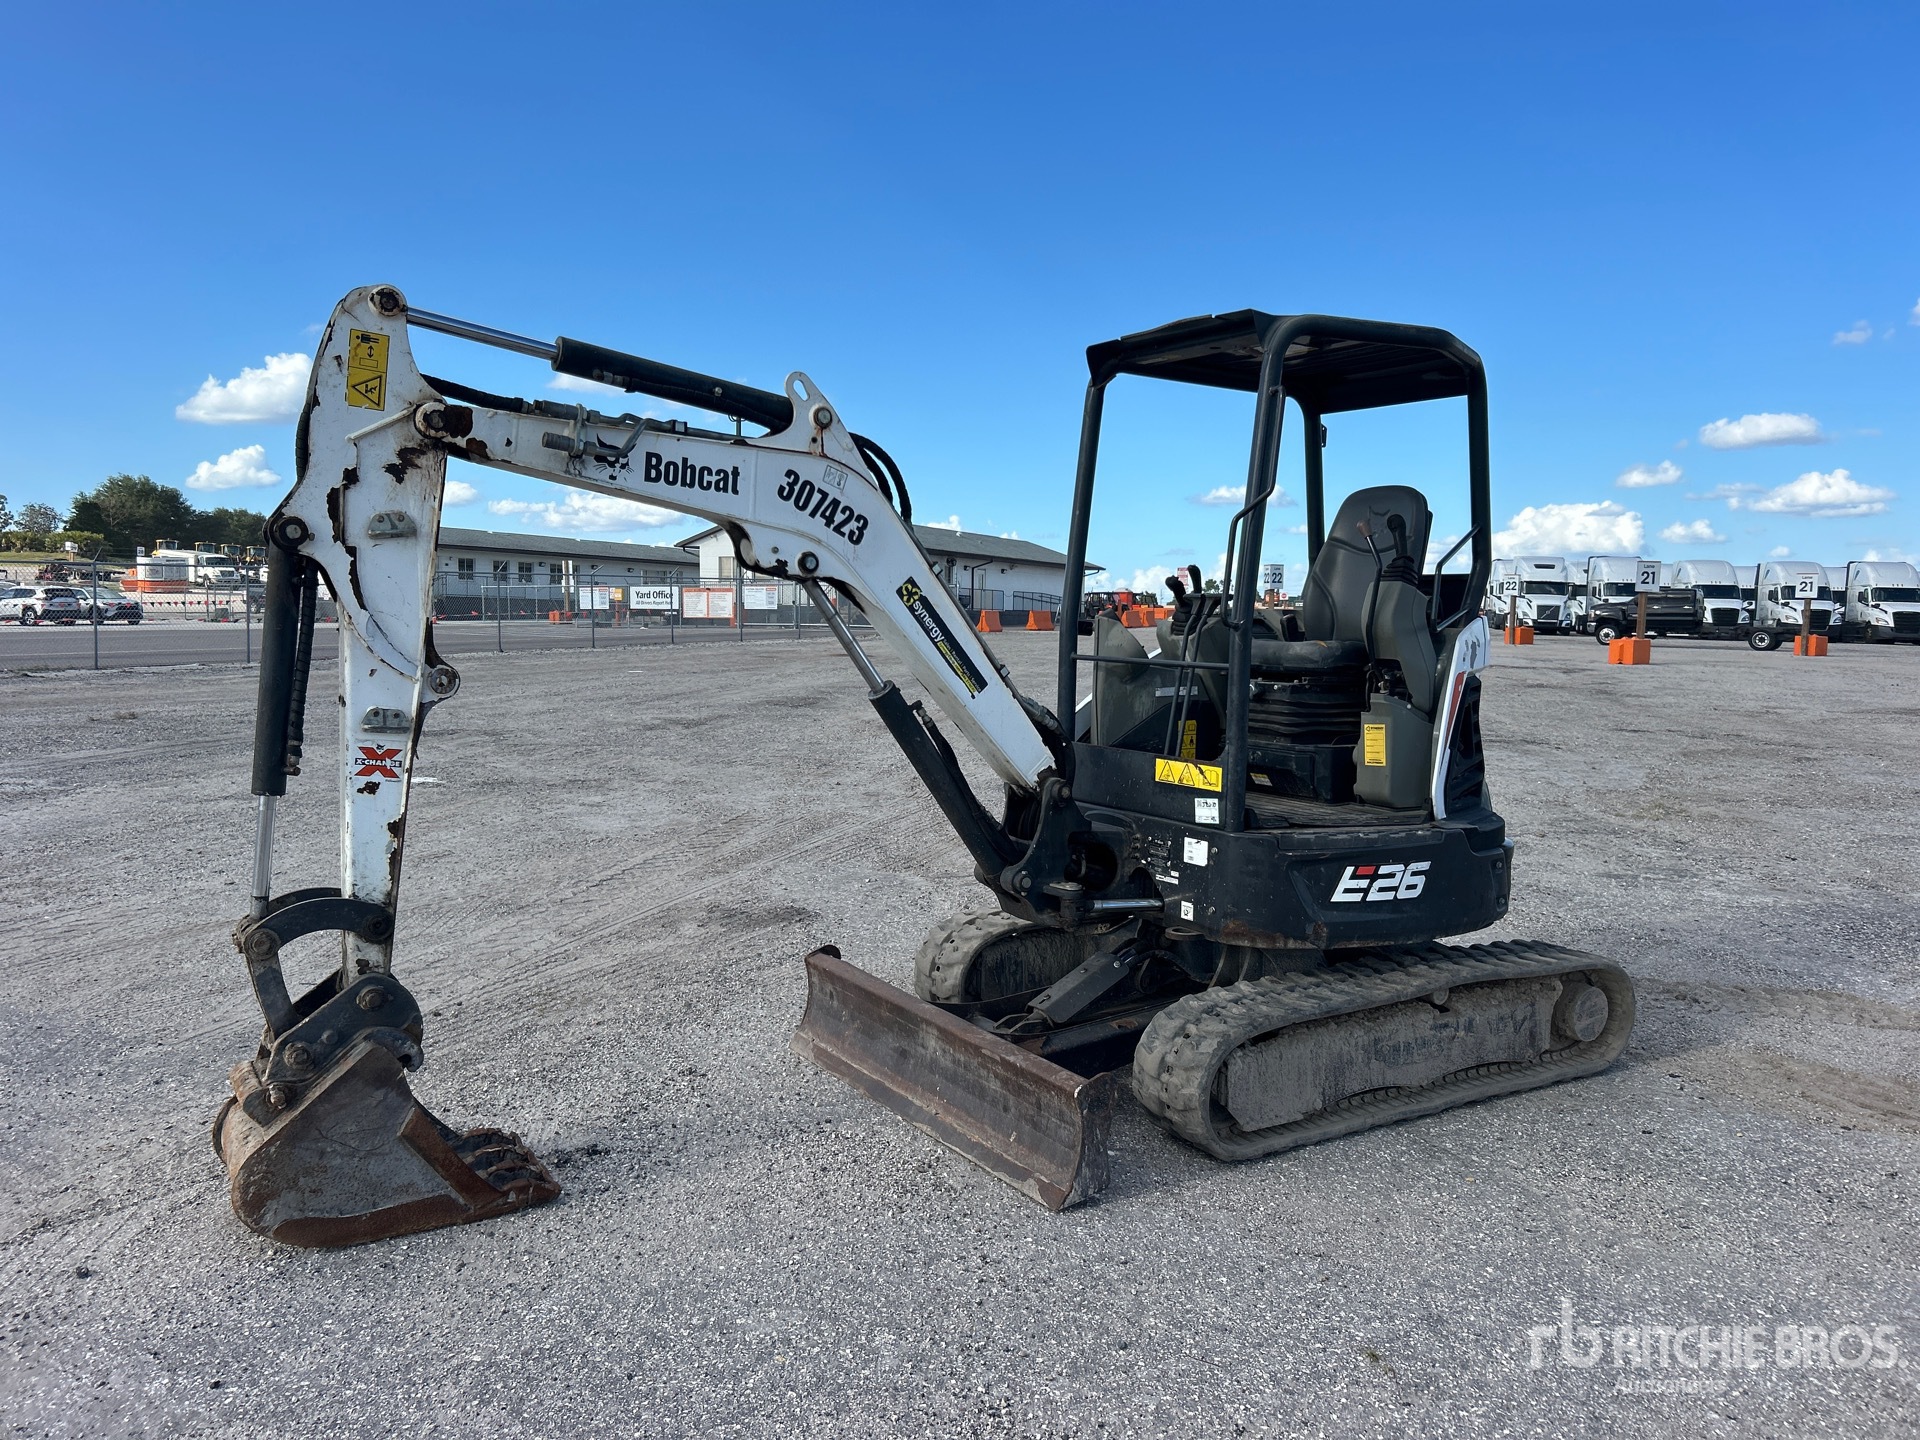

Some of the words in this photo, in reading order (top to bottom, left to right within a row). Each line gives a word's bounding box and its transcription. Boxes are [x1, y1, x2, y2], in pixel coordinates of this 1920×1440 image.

[643, 451, 741, 496] Bobcat
[777, 468, 869, 546] 307423
[1271, 572, 1283, 584] 22
[1640, 570, 1656, 585] 21
[1505, 581, 1517, 591] 22
[1799, 581, 1814, 593] 21
[635, 590, 651, 599] Yard
[652, 590, 674, 599] Office
[912, 600, 946, 643] synergy
[1329, 860, 1432, 902] E26
